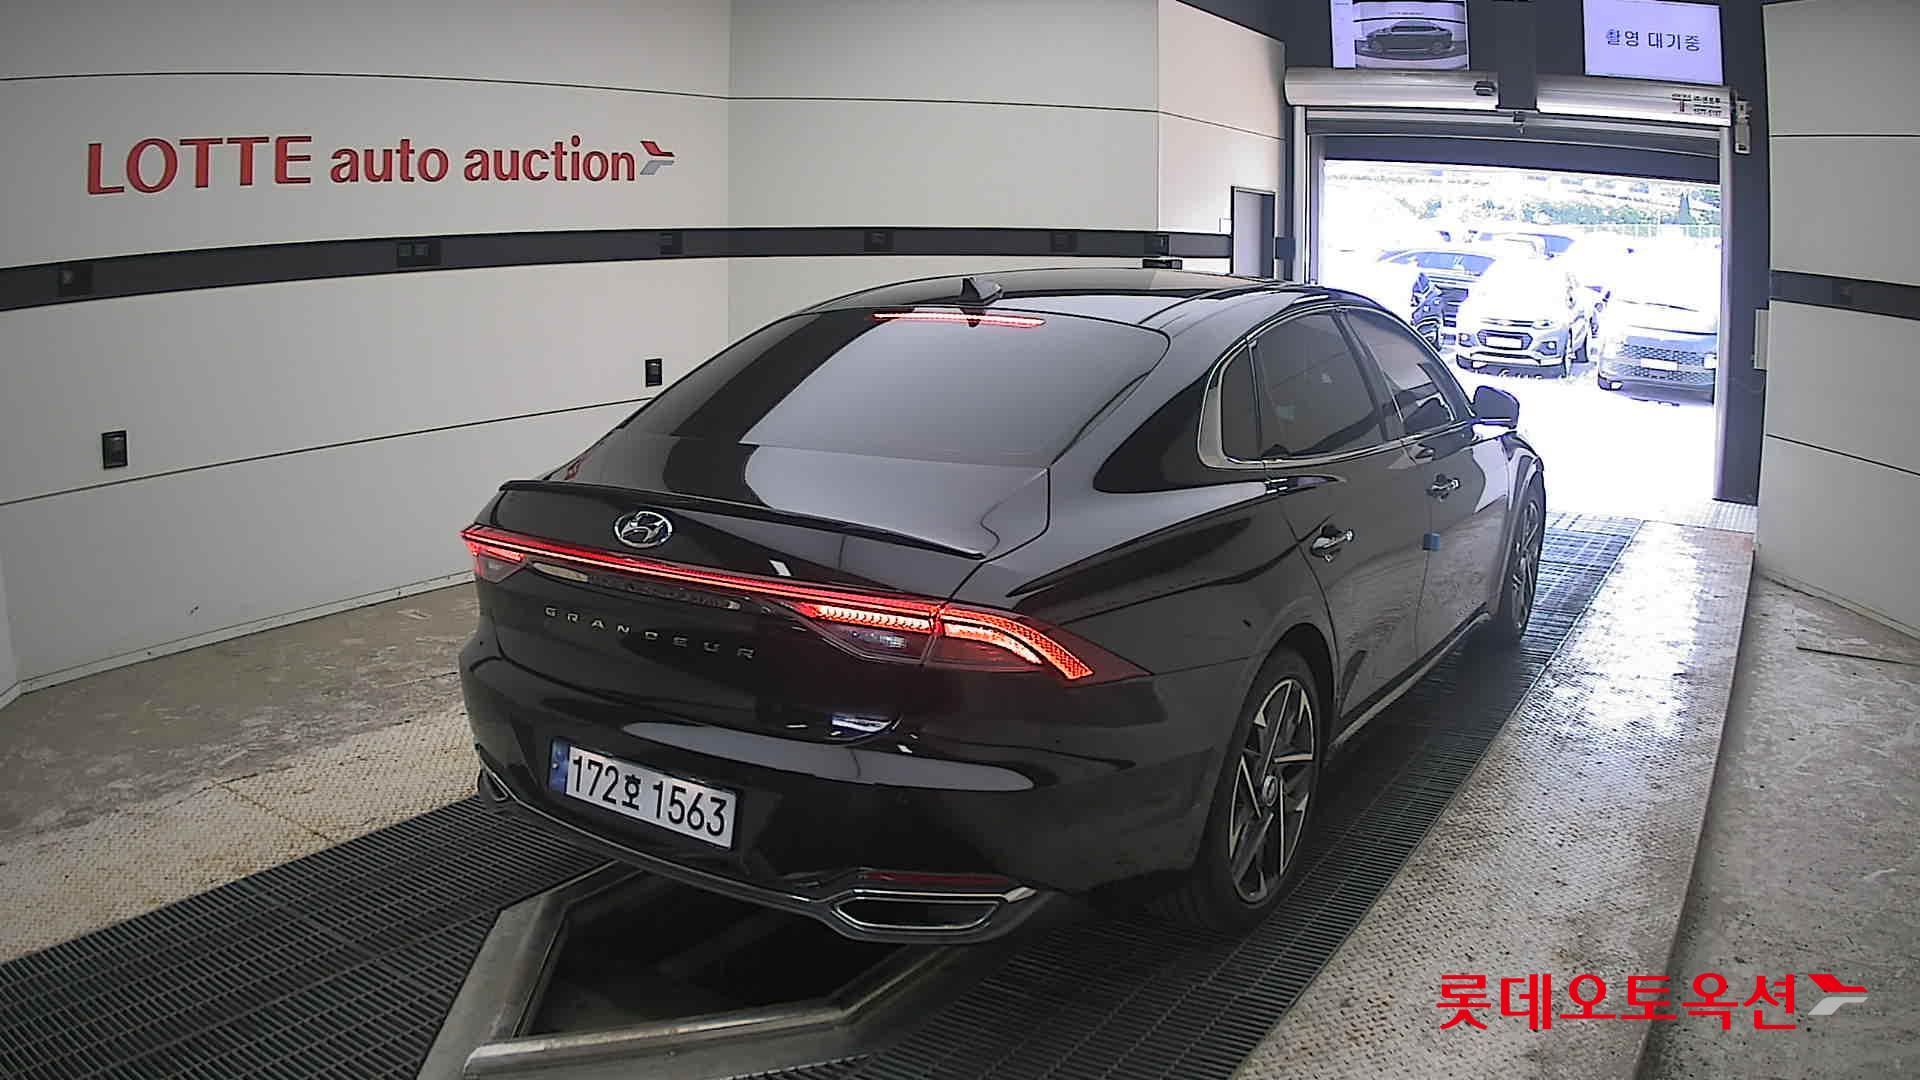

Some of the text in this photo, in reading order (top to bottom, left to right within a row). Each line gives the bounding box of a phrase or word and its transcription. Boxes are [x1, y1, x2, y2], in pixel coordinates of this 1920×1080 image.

[1648, 32, 1700, 52] 대기중
[88, 134, 635, 195] LOTTE auto auction
[545, 607, 755, 660] GRANDEUR
[573, 755, 728, 836] 172호 1563
